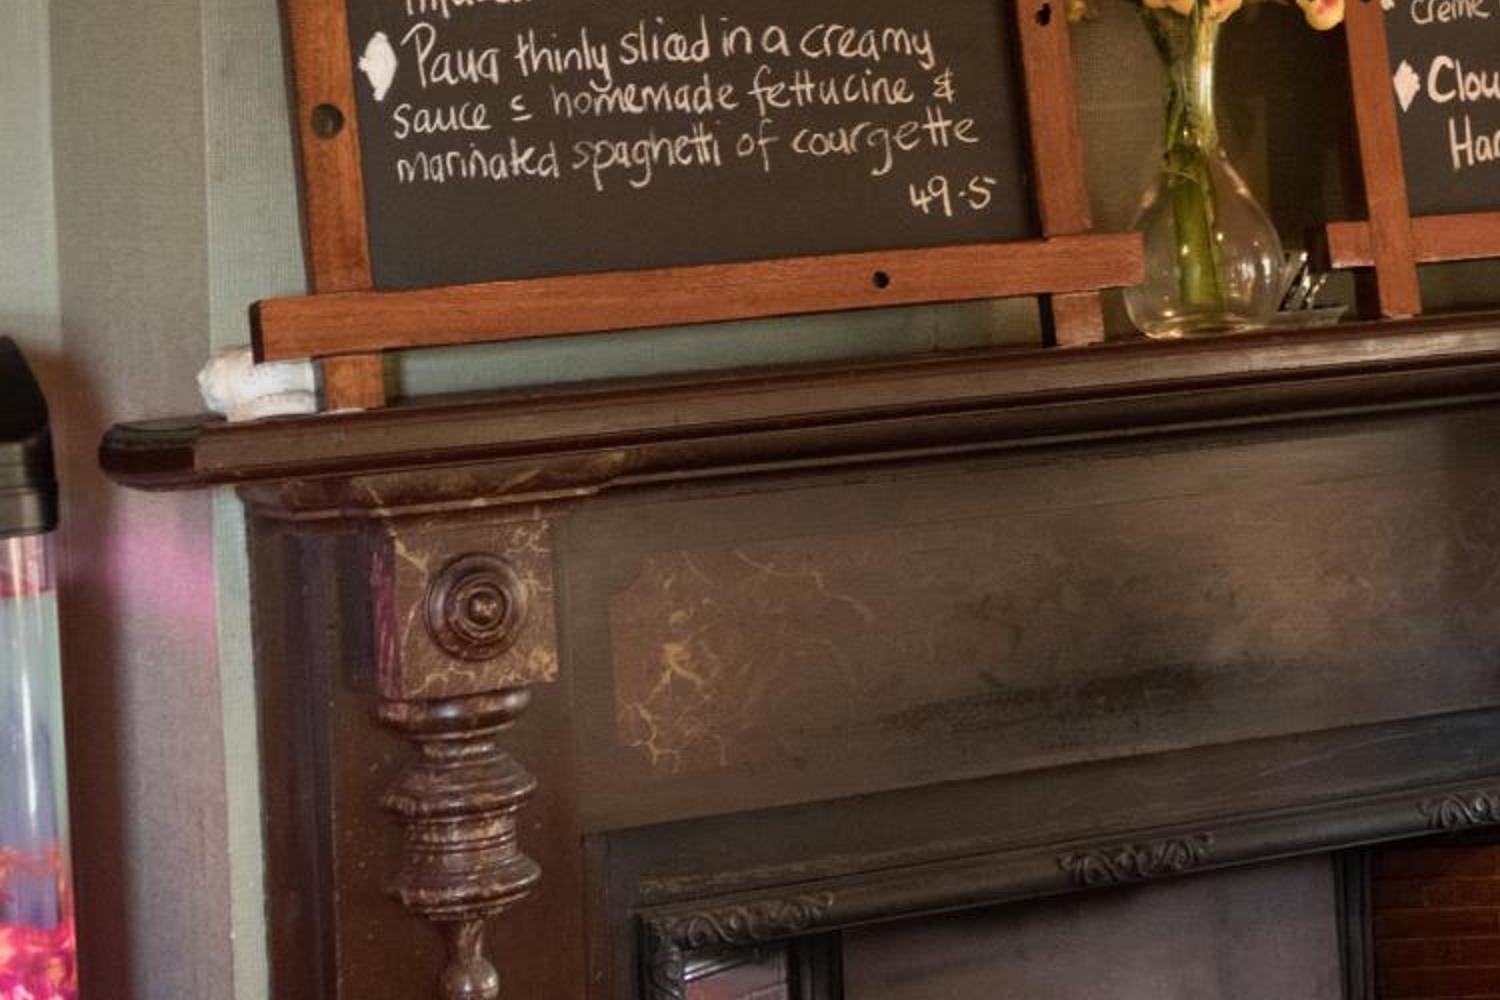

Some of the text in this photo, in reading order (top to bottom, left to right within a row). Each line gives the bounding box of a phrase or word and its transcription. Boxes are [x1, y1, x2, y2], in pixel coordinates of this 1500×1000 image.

[400, 13, 935, 92] Paua thinly sliced in a creamy
[393, 102, 493, 140] sauce
[549, 72, 739, 119] homemade
[747, 63, 915, 117] fettucine
[932, 66, 956, 105] &
[397, 105, 980, 192] marinated spaghetti of courgette
